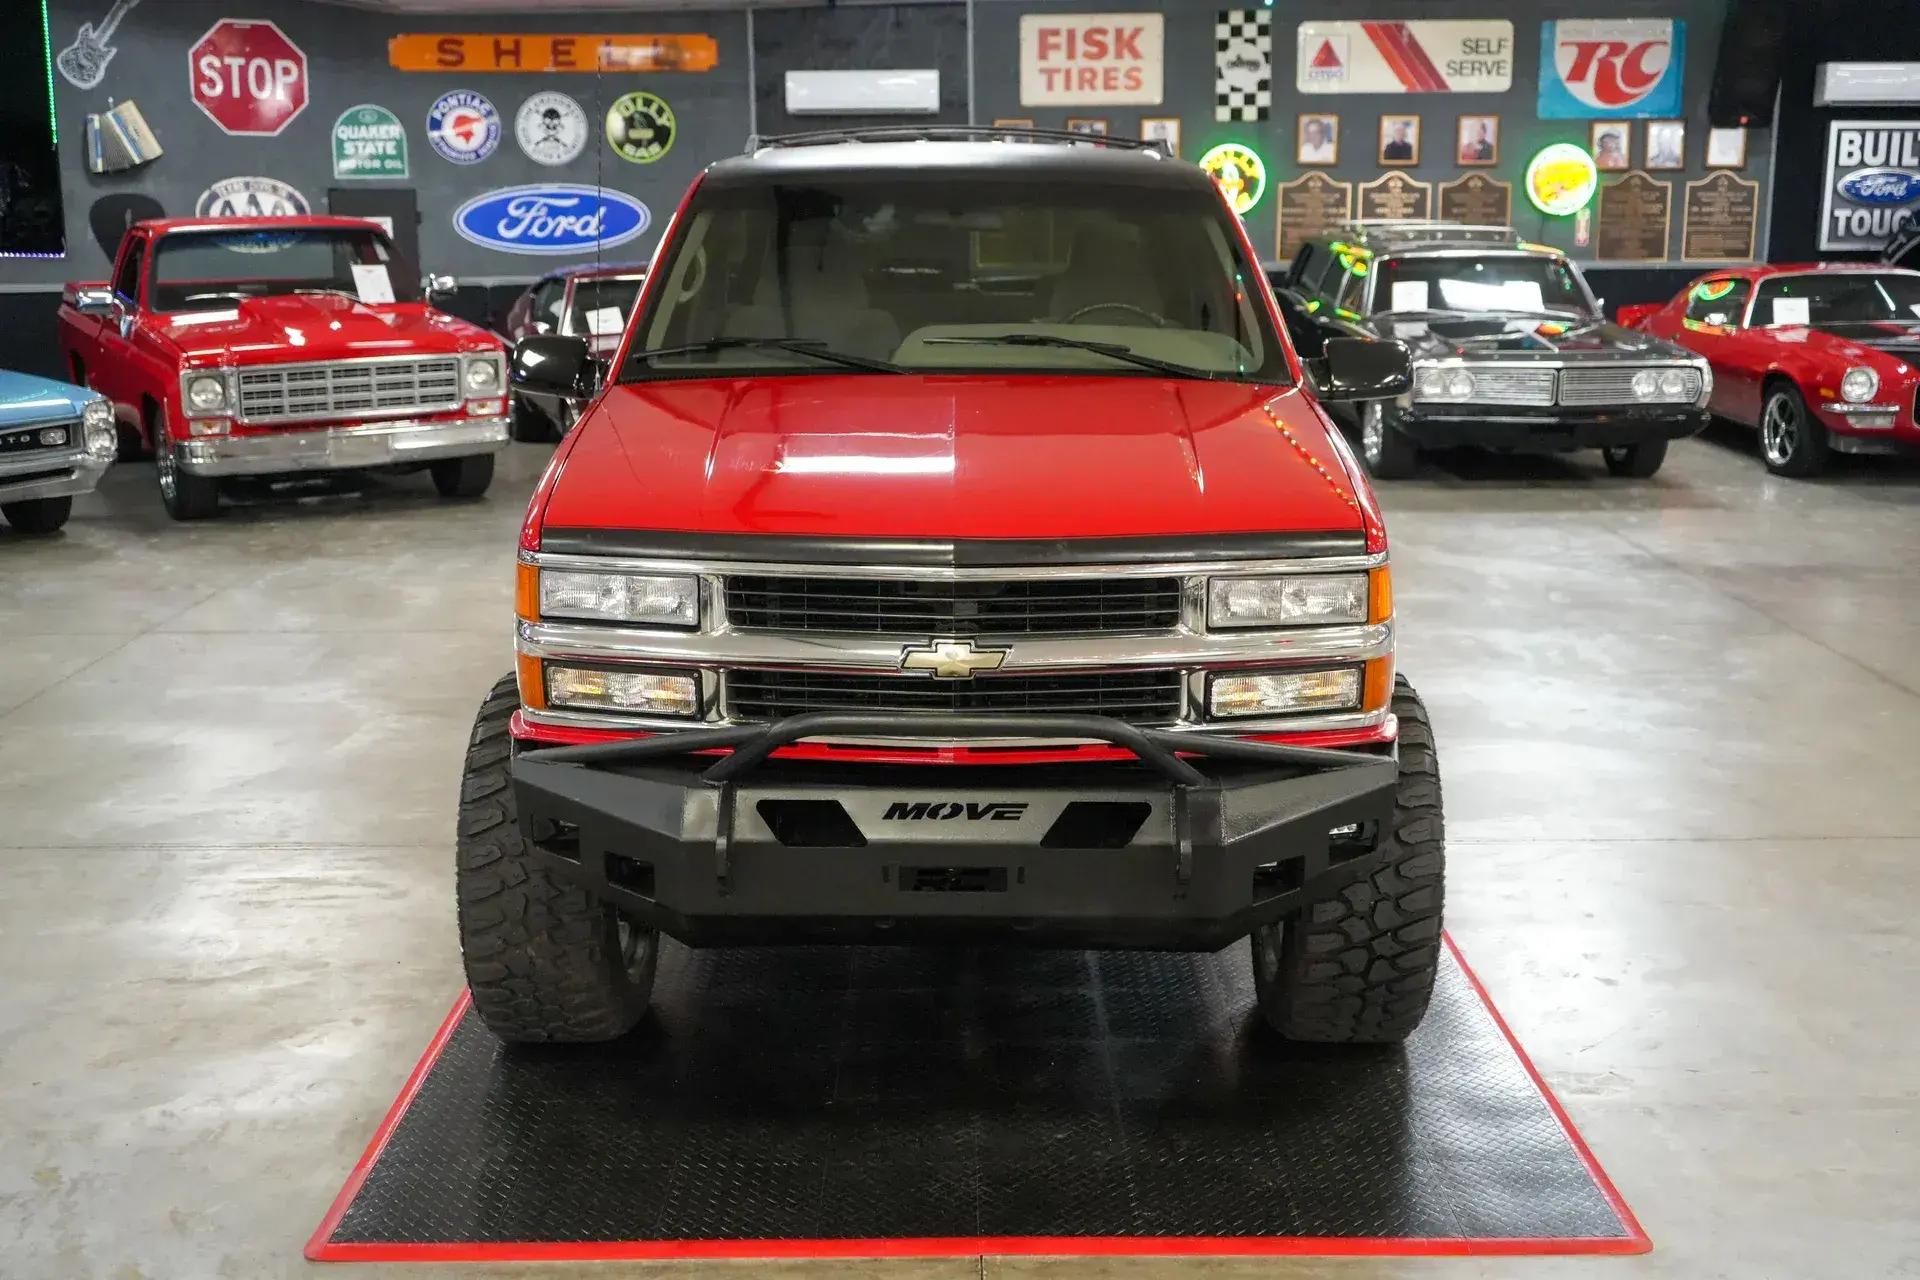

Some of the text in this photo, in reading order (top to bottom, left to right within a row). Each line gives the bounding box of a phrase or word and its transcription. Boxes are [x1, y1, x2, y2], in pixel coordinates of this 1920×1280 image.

[436, 38, 682, 68] SHELL
[1037, 27, 1144, 61] FISK
[1461, 37, 1509, 55] SELF
[199, 54, 299, 101] STOP
[1039, 66, 1144, 92] TIRES
[1446, 59, 1508, 77] SERVE
[1560, 41, 1669, 106] RC
[431, 93, 492, 121] PONTIAC
[337, 124, 402, 141] QUAKER
[343, 140, 398, 156] STATE
[1838, 130, 1920, 167] BUIL
[1859, 174, 1908, 199] Ford
[497, 196, 607, 239] Ford
[0, 434, 31, 446] TO
[882, 802, 1030, 821] MOVE
